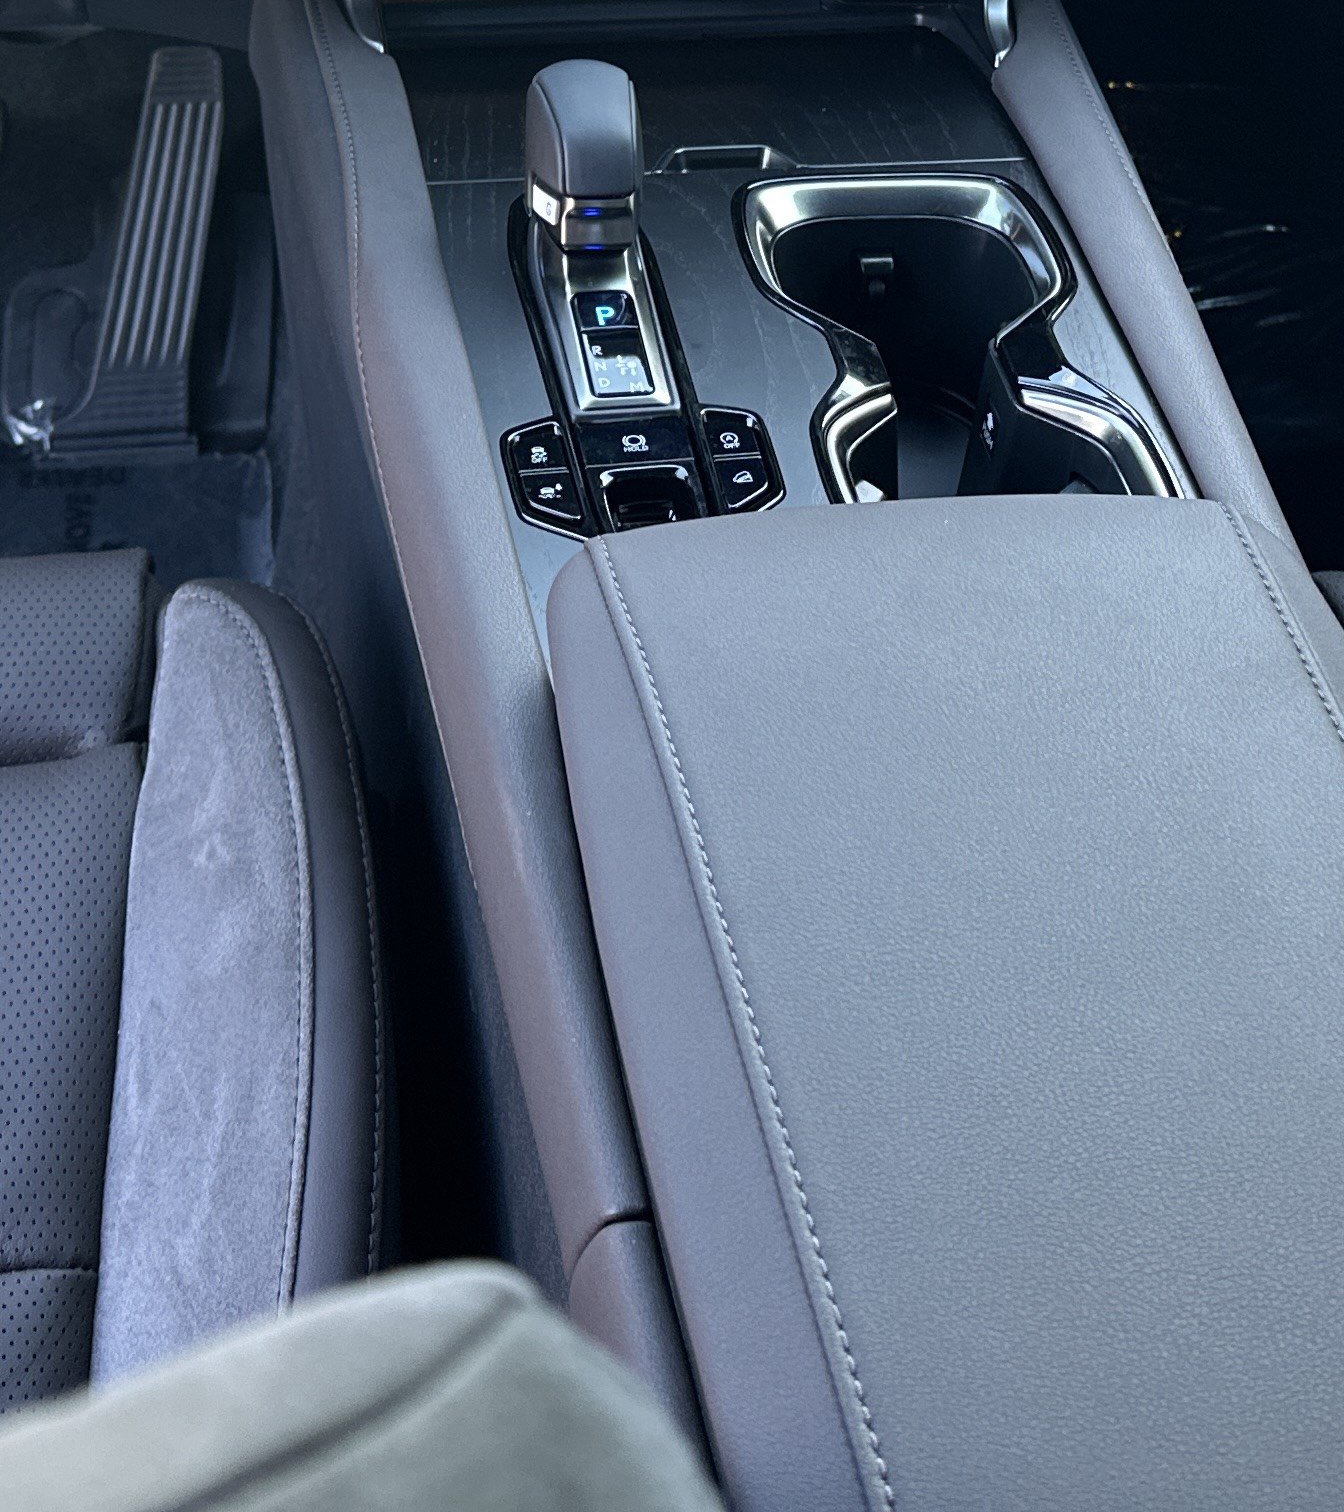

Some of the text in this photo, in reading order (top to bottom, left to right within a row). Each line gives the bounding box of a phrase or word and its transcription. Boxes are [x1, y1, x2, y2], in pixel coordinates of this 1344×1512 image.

[594, 305, 616, 327] P
[591, 344, 604, 357] R
[594, 361, 608, 373] N
[598, 376, 611, 389] D
[629, 380, 645, 394] M
[622, 444, 650, 454] HOLD
[530, 455, 548, 465] OFF
